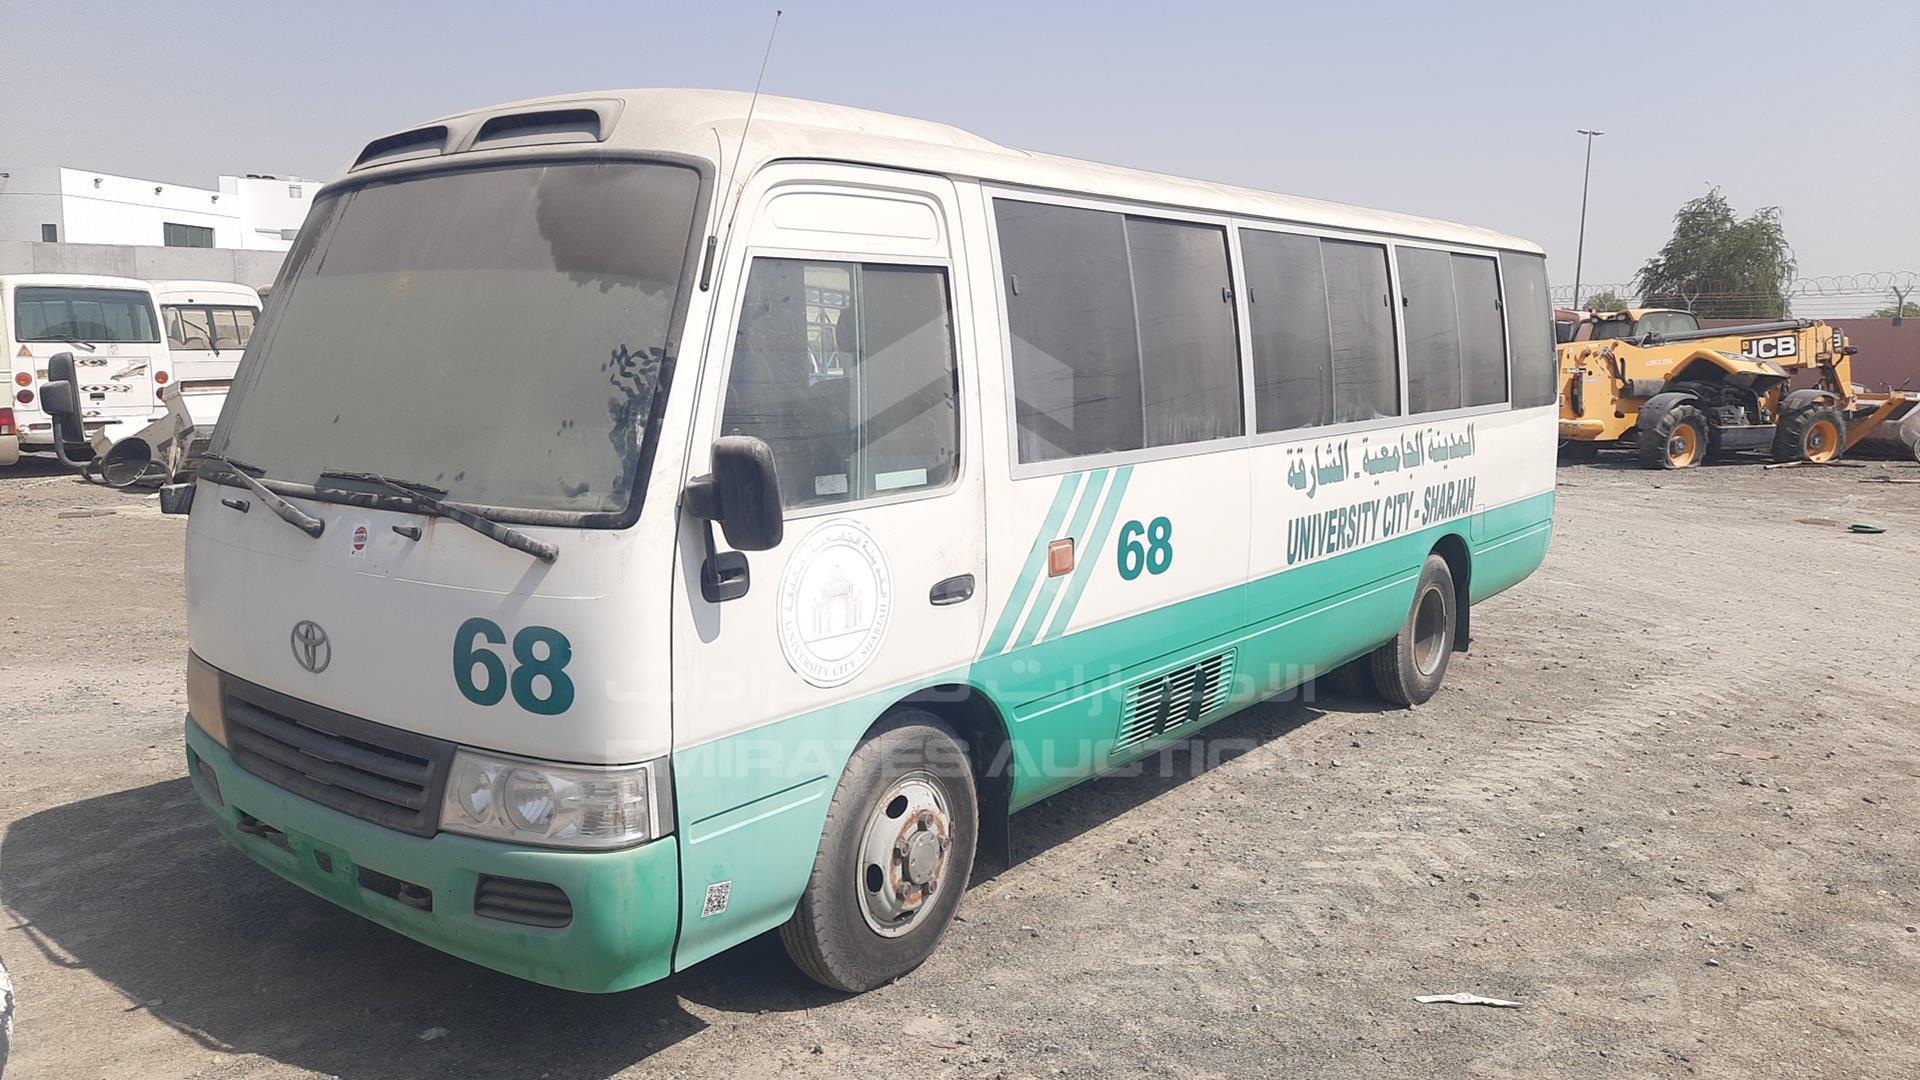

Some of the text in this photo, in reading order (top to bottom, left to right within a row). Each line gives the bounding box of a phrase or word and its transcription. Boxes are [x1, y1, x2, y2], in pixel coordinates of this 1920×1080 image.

[1742, 336, 1796, 358] JCB
[1286, 439, 1349, 499] الشارقة
[1362, 430, 1425, 486] الجامعية
[1427, 421, 1476, 470] المدينة
[1117, 516, 1173, 581] 68
[1286, 499, 1381, 565] UNIVERSITY
[1383, 491, 1415, 538] CITY
[1421, 476, 1476, 526] SHARJAH
[453, 617, 575, 716] 68
[832, 658, 858, 677] CITY
